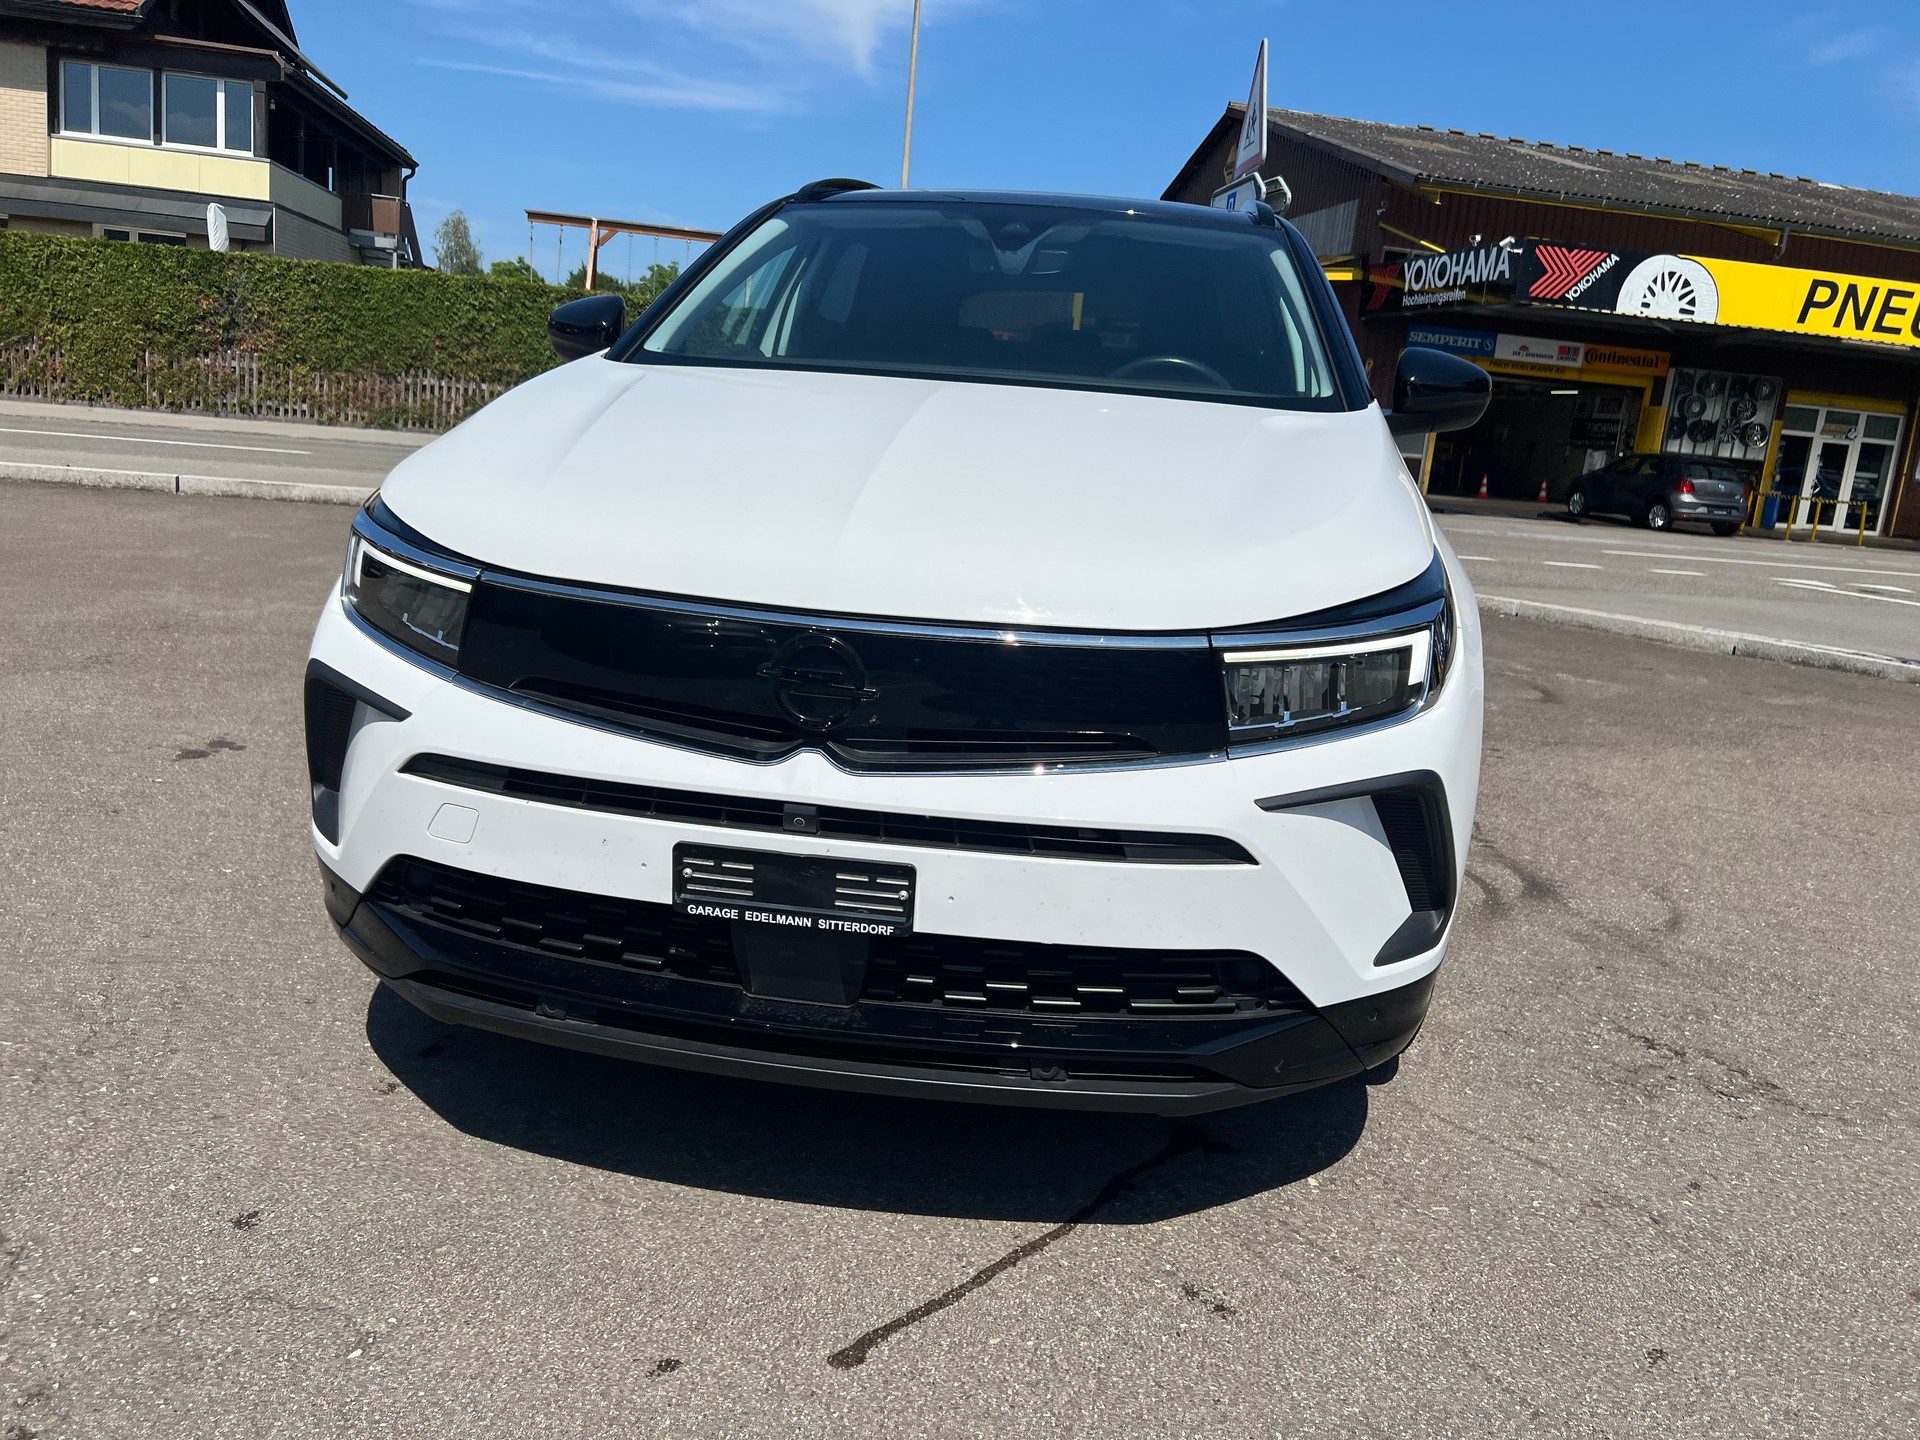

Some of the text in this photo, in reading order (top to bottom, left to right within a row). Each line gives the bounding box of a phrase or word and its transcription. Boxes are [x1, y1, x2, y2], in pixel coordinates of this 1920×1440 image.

[1403, 247, 1510, 292] YOKOHAMA
[1564, 253, 1620, 301] YOKOHAMA
[1402, 288, 1466, 307] Hochleistungsreifen
[1408, 331, 1482, 349] SEMPERIT
[1584, 347, 1660, 368] Continental
[687, 904, 895, 936] GARAGE EDELMANN SITTERDORF
